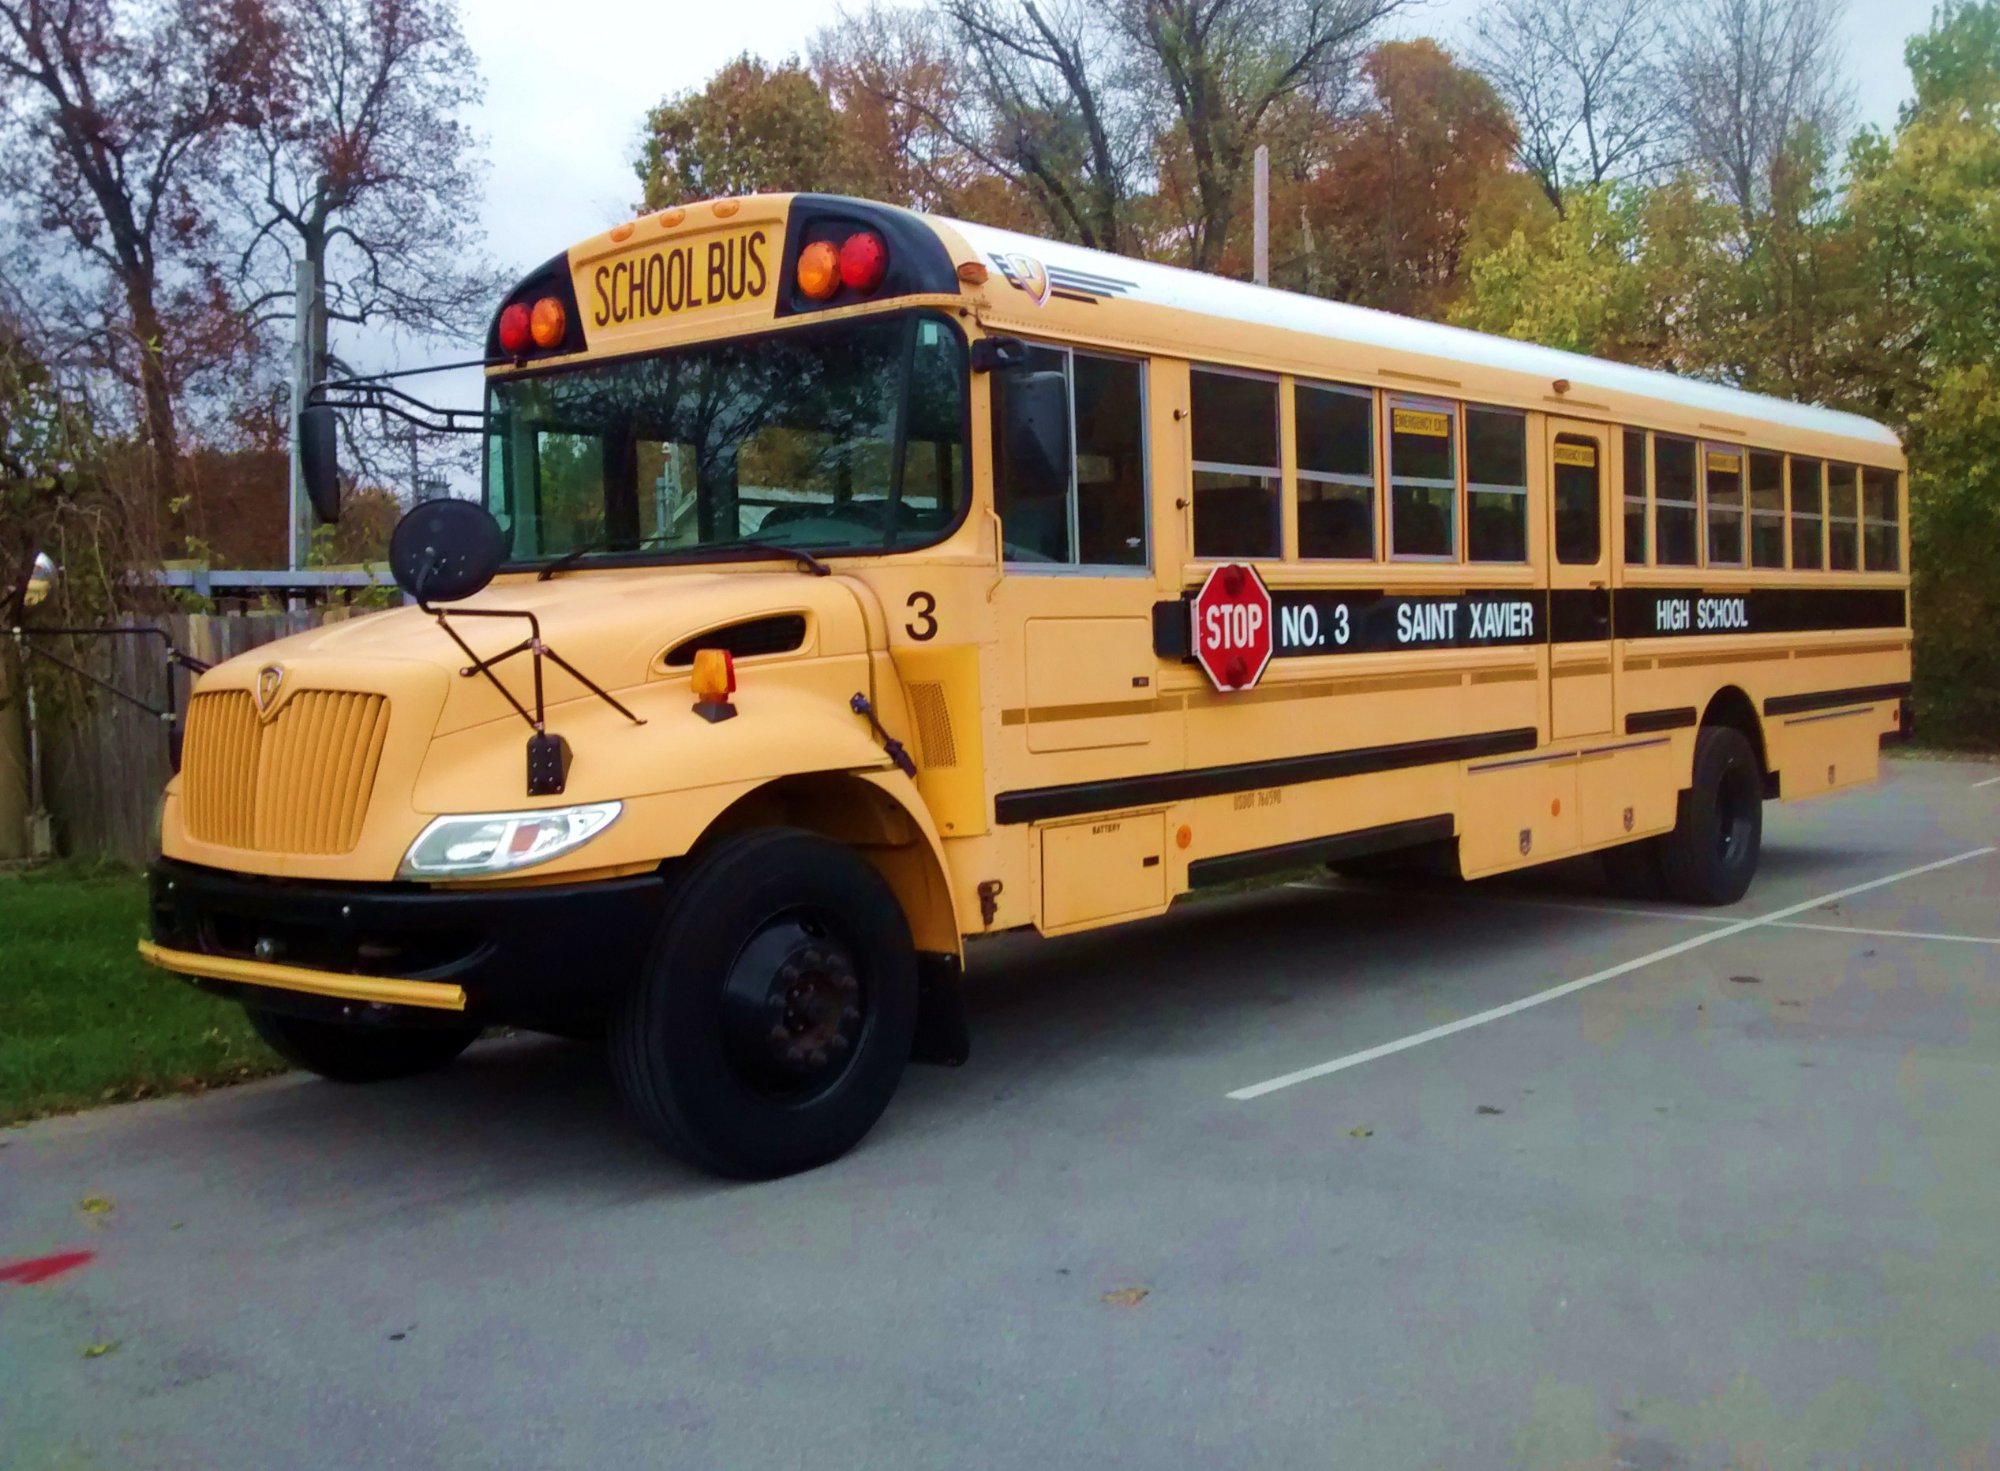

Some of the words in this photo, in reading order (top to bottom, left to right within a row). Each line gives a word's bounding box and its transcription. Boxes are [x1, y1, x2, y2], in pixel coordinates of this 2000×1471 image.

[595, 247, 702, 327] SCHOOL
[707, 230, 766, 305] BUS
[905, 591, 938, 642] 3
[1206, 603, 1263, 650] STOP
[1281, 604, 1325, 647] NO.
[1334, 603, 1350, 645] 3
[1397, 602, 1457, 643] SAINT
[1469, 601, 1534, 639] XAVIER
[1656, 599, 1690, 631] HIGH
[1697, 598, 1748, 629] SCHOOL
[1092, 823, 1120, 835] BATTERY
